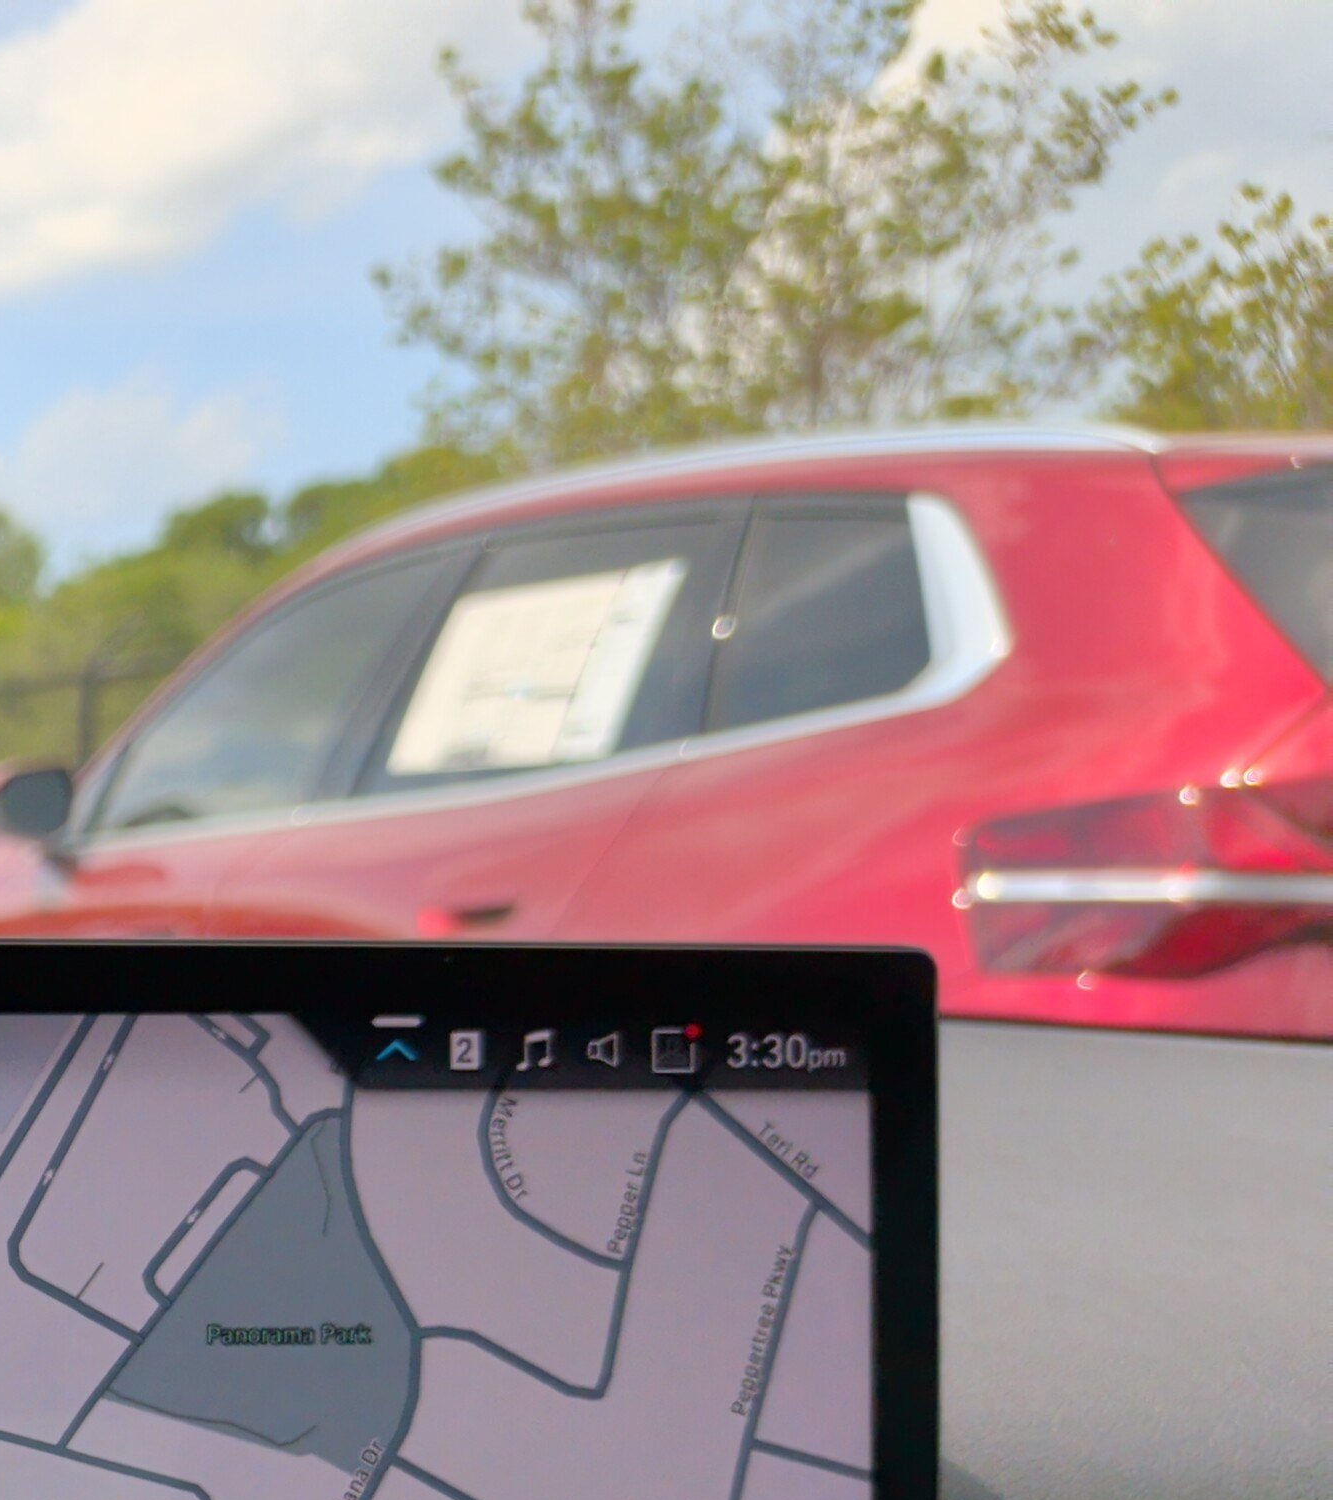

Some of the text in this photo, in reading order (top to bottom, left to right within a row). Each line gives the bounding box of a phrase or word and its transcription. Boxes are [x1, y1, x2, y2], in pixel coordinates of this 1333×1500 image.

[455, 1037, 472, 1064] 2
[491, 1098, 528, 1199] Merritt Dr
[791, 1151, 819, 1179] Rd
[607, 1152, 646, 1254] Pepper Ln
[206, 1322, 372, 1346] Panorama Park
[730, 1245, 794, 1416] Peppertree Pkwy
[361, 1441, 384, 1465] Dr
